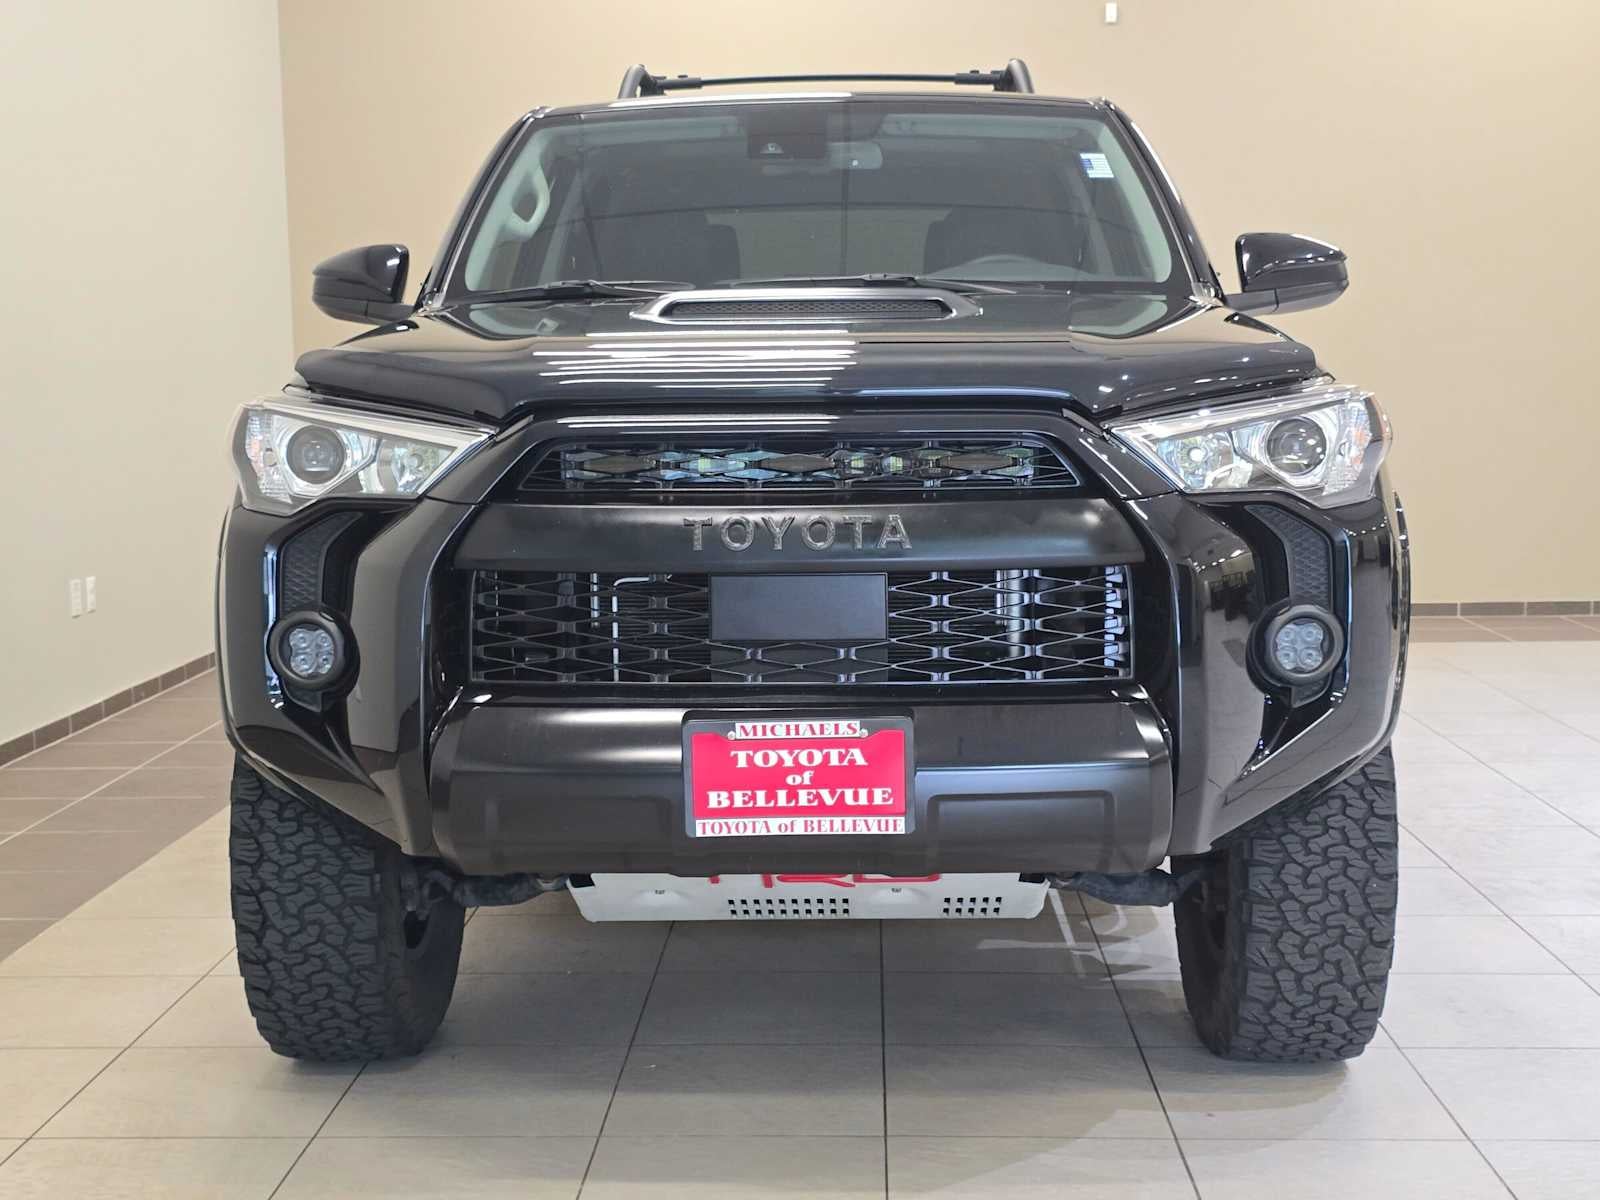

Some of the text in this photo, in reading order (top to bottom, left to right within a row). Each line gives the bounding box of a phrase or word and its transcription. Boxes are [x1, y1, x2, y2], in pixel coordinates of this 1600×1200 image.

[683, 512, 912, 551] TOYOTA
[738, 722, 858, 738] MICHAELS
[730, 748, 868, 769] TOYOTA
[785, 770, 814, 786] of
[706, 788, 893, 809] BELLEVUE
[697, 818, 904, 836] TOYOTA of BELLEVUE
